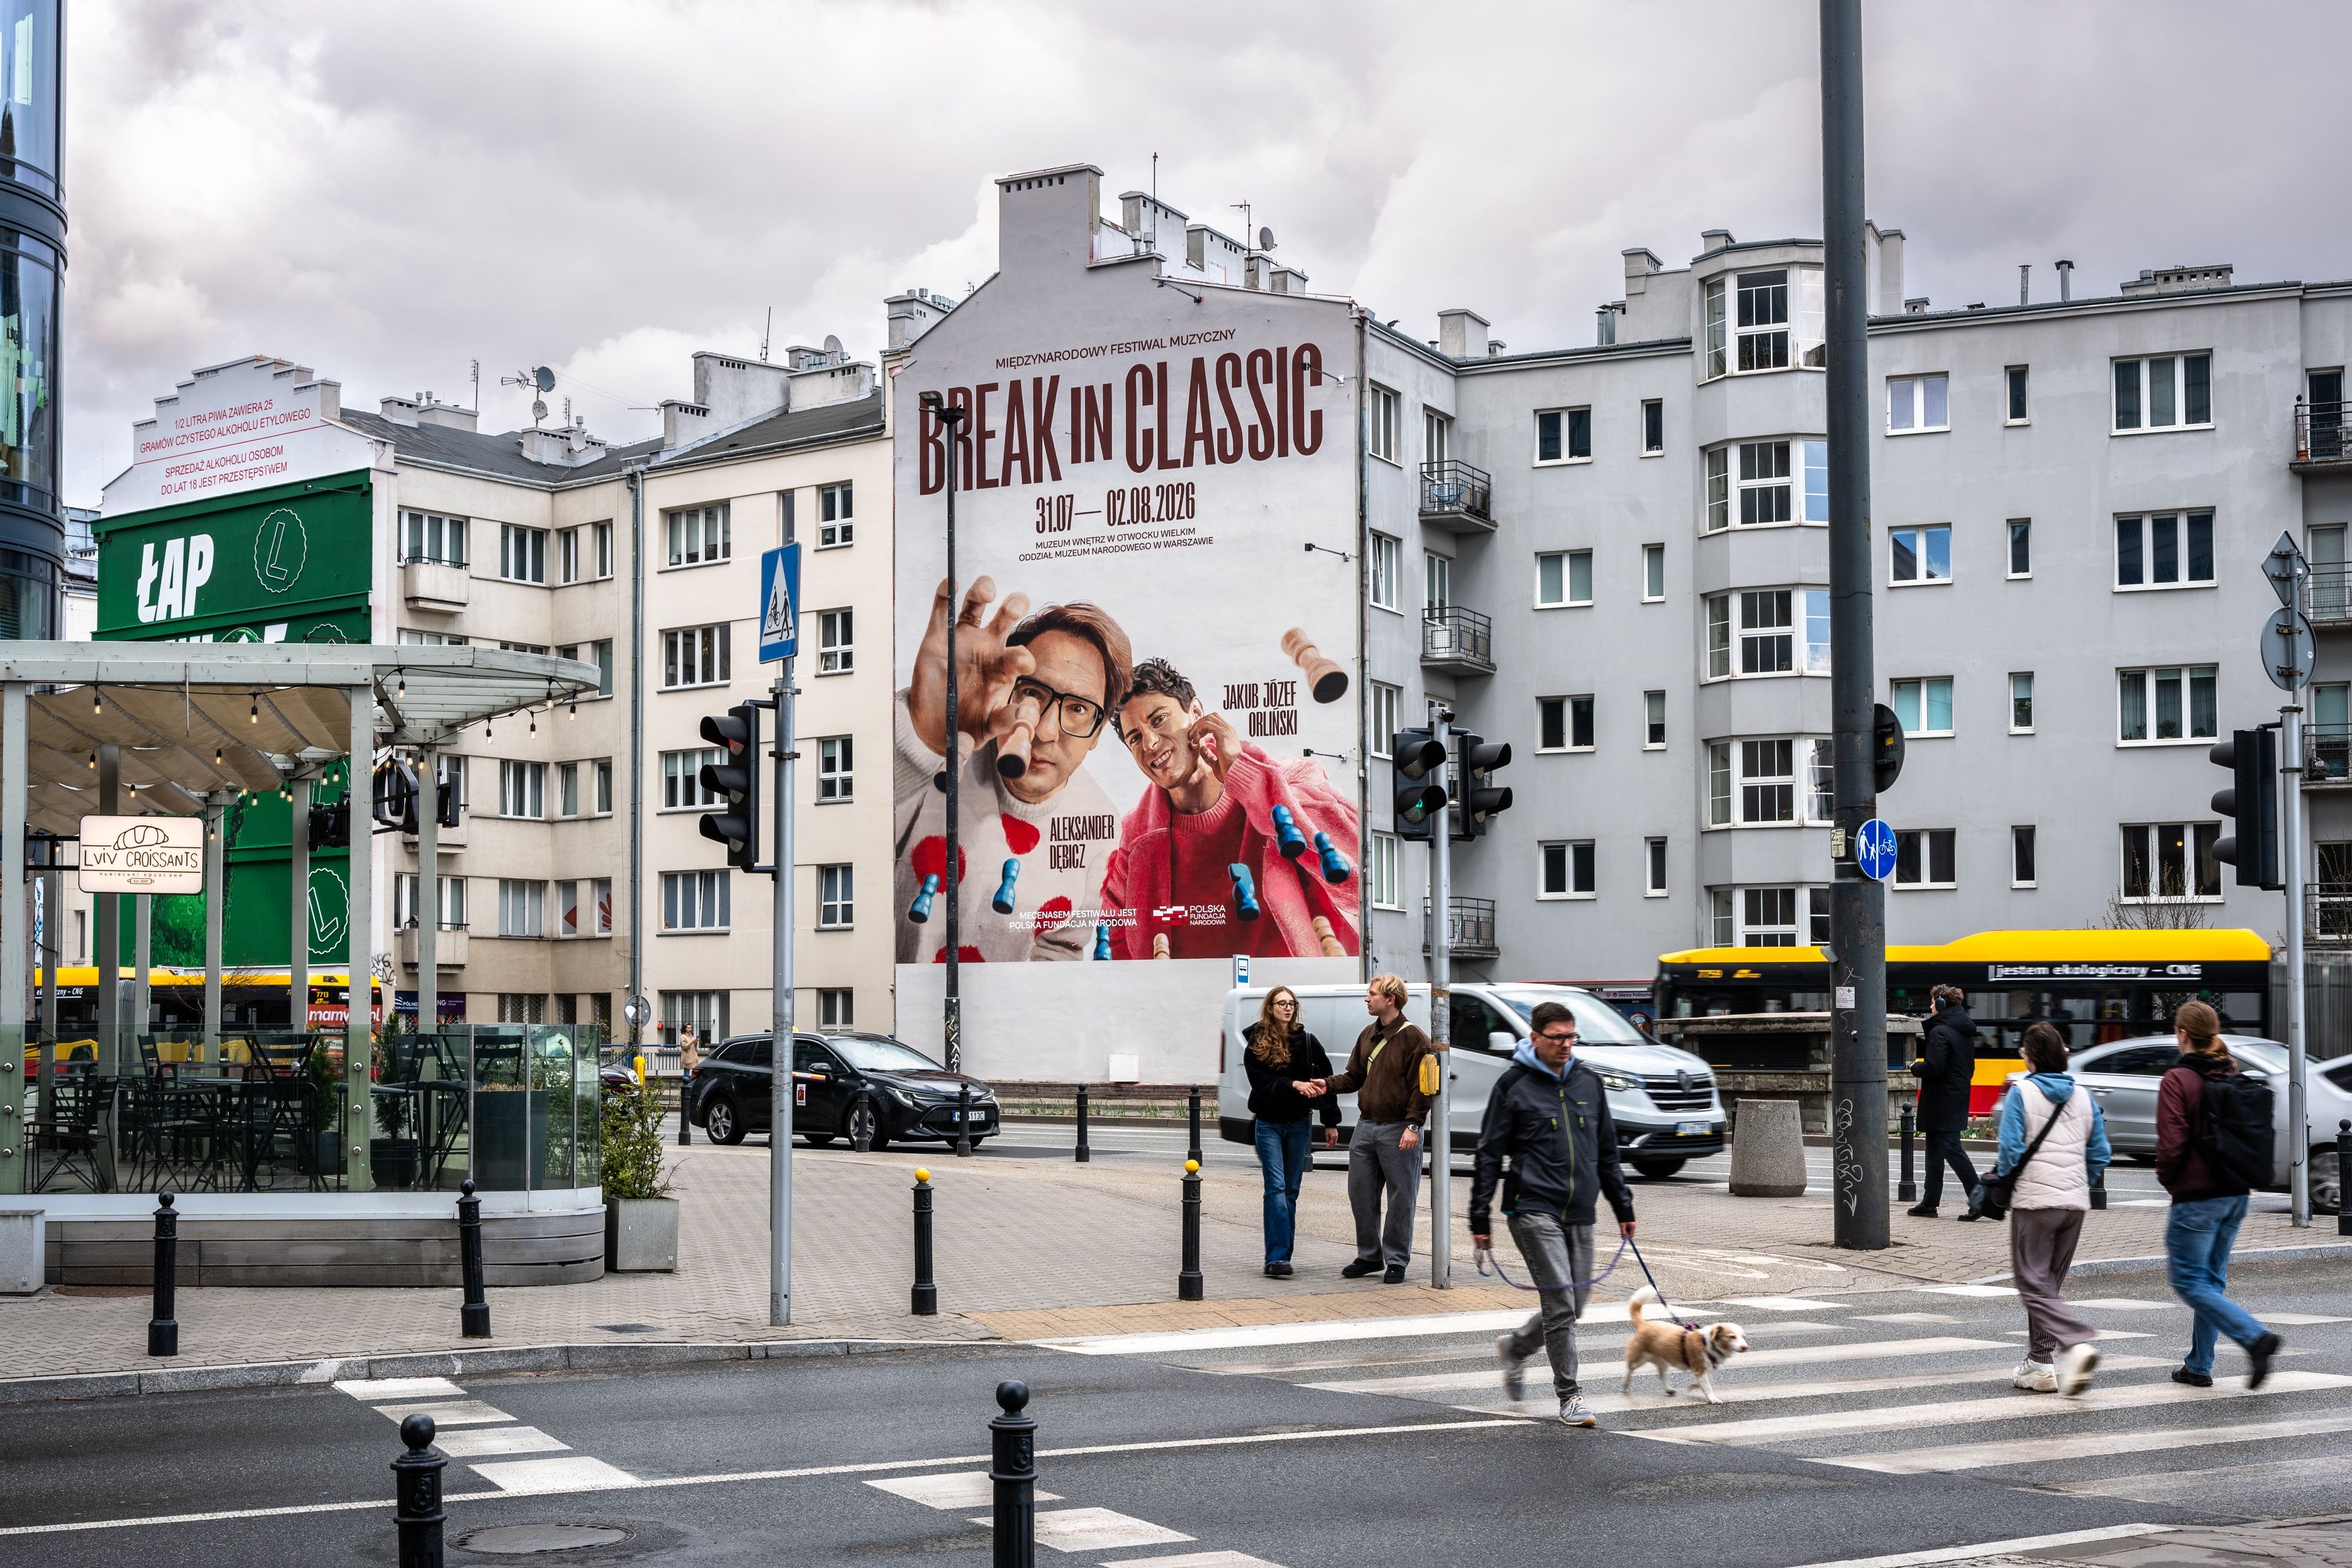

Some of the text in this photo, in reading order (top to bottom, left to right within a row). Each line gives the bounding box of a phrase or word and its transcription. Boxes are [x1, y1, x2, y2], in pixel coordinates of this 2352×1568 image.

[995, 328, 1236, 369] MIĘDZYNARODOWY FESTIWAL MUZYCZNY
[174, 399, 273, 430] 1/2 LITRA PIWA ZAWIERA 25
[919, 342, 1323, 495] BREAK IN CLASSIC
[140, 408, 310, 453] GRAMÓW CZYSTEGO ALKOHOLU ETYLOWEGO
[165, 445, 283, 478] SPRZEDAŻ ALKOHOLU OSOBOM
[161, 461, 287, 495] DO LAT 18 JEST PRZESTĘPSTWEM
[1106, 482, 1195, 526] 02.08.2026
[1019, 536, 1214, 561] ODDZIAŁ MUZEUM NARODOWEGO W WARSZAWIE
[1036, 527, 1195, 549] MUZEUM WNĘTRZ W OTWOCKU WIELKIM
[137, 534, 215, 623] ŁAP
[1223, 679, 1296, 710] JAKUB JÓZEF
[1249, 707, 1297, 737] ORLIŃSKI
[1050, 815, 1114, 842] ALEKSANDER
[1050, 844, 1086, 873] DĘBICZ
[1009, 918, 1138, 930] POLSKA FUNDACJA NARODOWA
[1019, 908, 1137, 920] MECENASEM FESTIWALU JEST
[1190, 905, 1226, 913] POLSKA
[1995, 965, 2049, 977] jestem
[2052, 964, 2149, 977] ekologiczny
[2166, 965, 2201, 975] CNG
